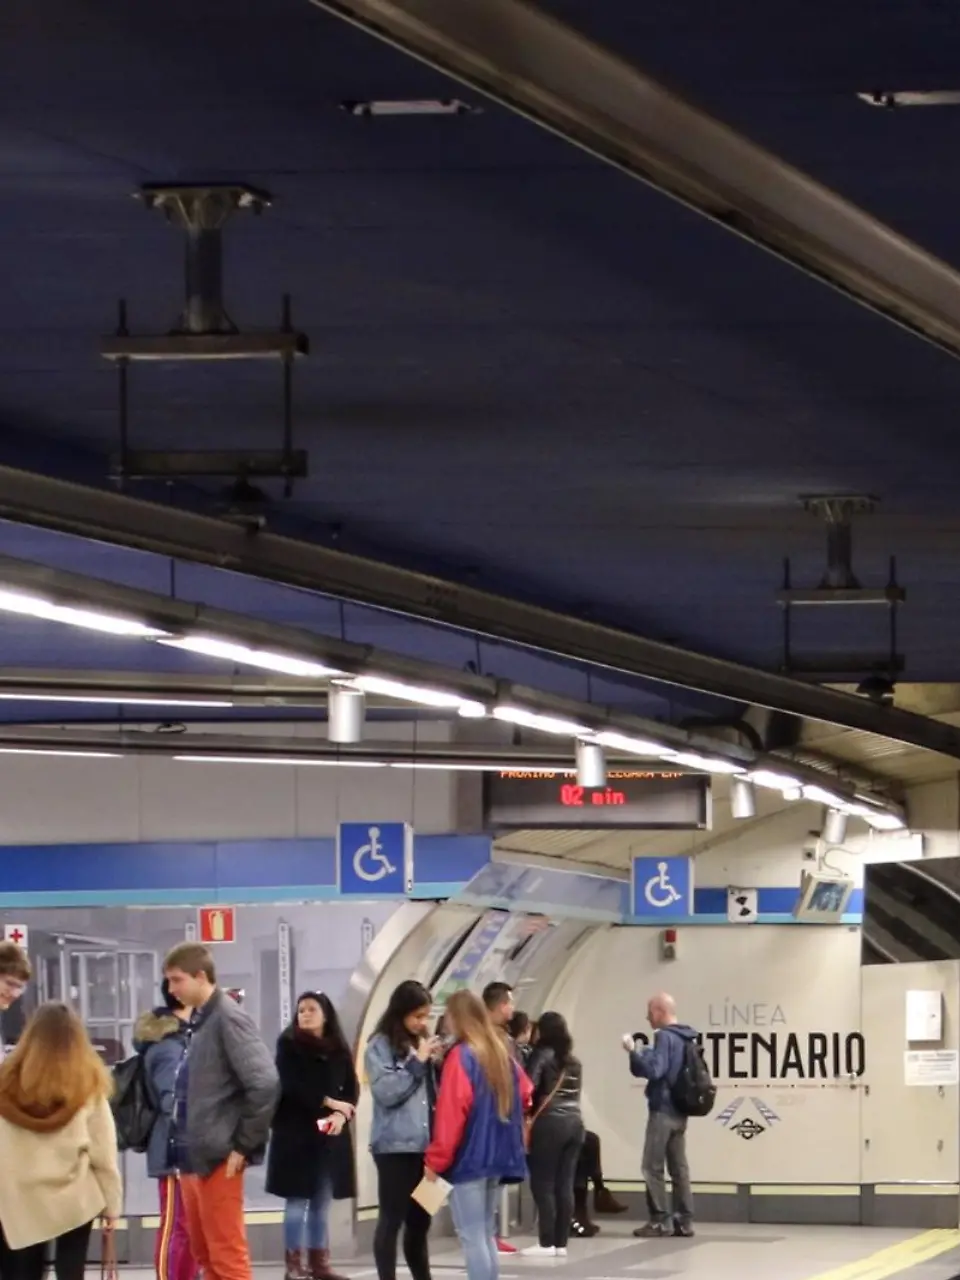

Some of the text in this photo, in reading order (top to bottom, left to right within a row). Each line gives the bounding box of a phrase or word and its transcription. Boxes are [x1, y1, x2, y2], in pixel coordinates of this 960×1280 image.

[561, 786, 625, 805] 02 min
[708, 997, 787, 1026] LÍNEA
